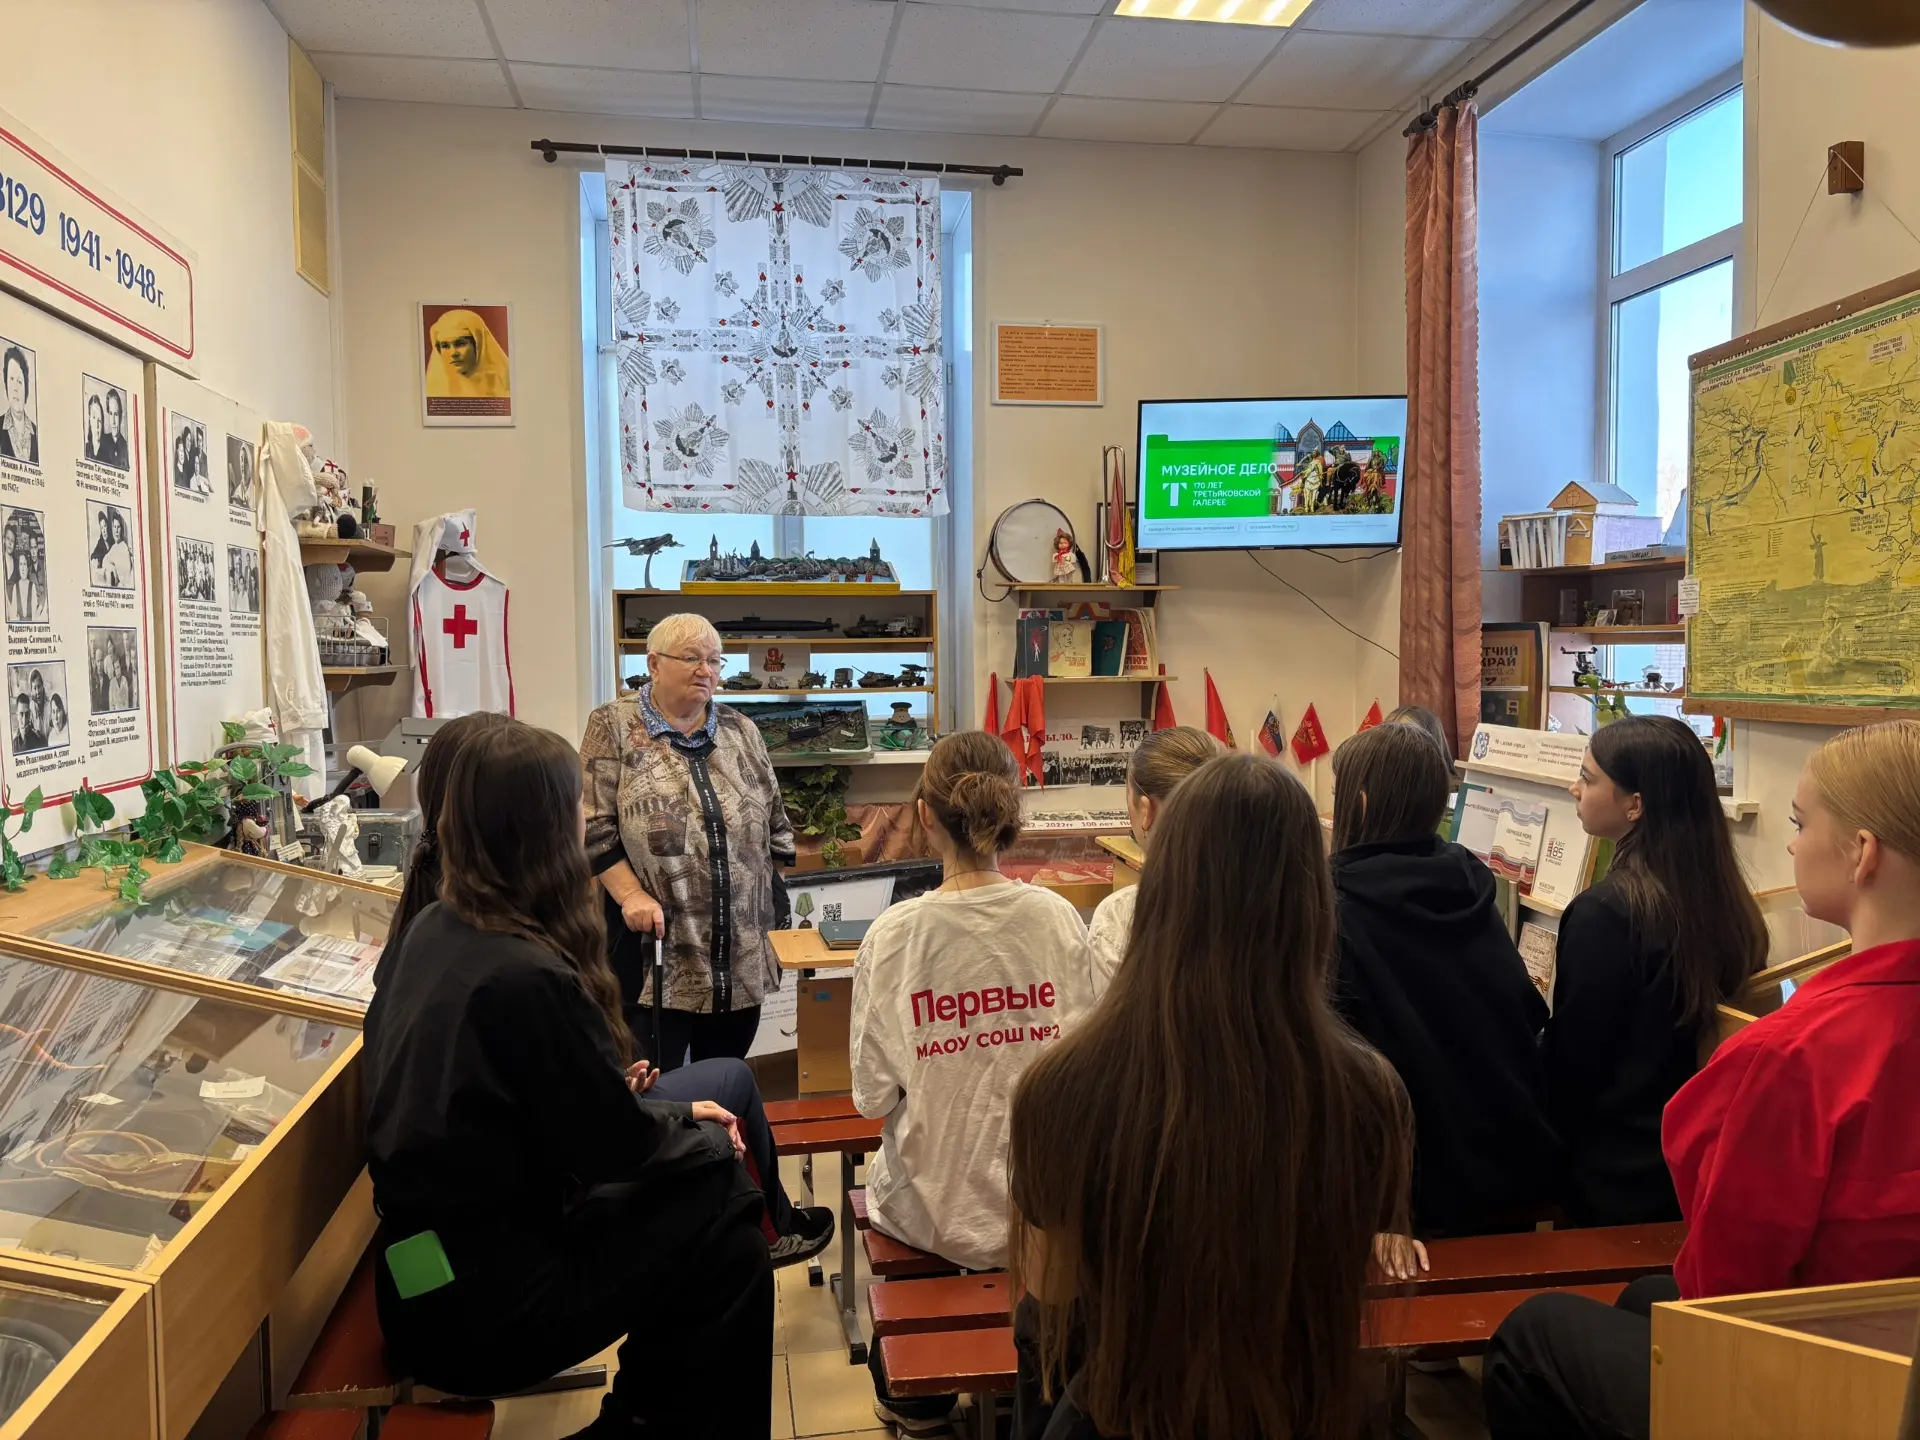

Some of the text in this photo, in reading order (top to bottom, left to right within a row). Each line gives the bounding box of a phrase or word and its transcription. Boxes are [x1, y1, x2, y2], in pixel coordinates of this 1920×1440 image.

[1162, 462, 1278, 476] МУЗЕЙНОЕ ДЕЛО
[1208, 481, 1223, 489] ЛЕТ
[1193, 489, 1261, 498] ТРЕТЬЯКОВСКОЙ
[1482, 644, 1519, 656] ТЧИЙ
[1552, 847, 1564, 859] 85
[911, 981, 1055, 1028] Первые
[916, 1034, 970, 1060] МАОУ
[976, 1027, 1024, 1048] СОШ
